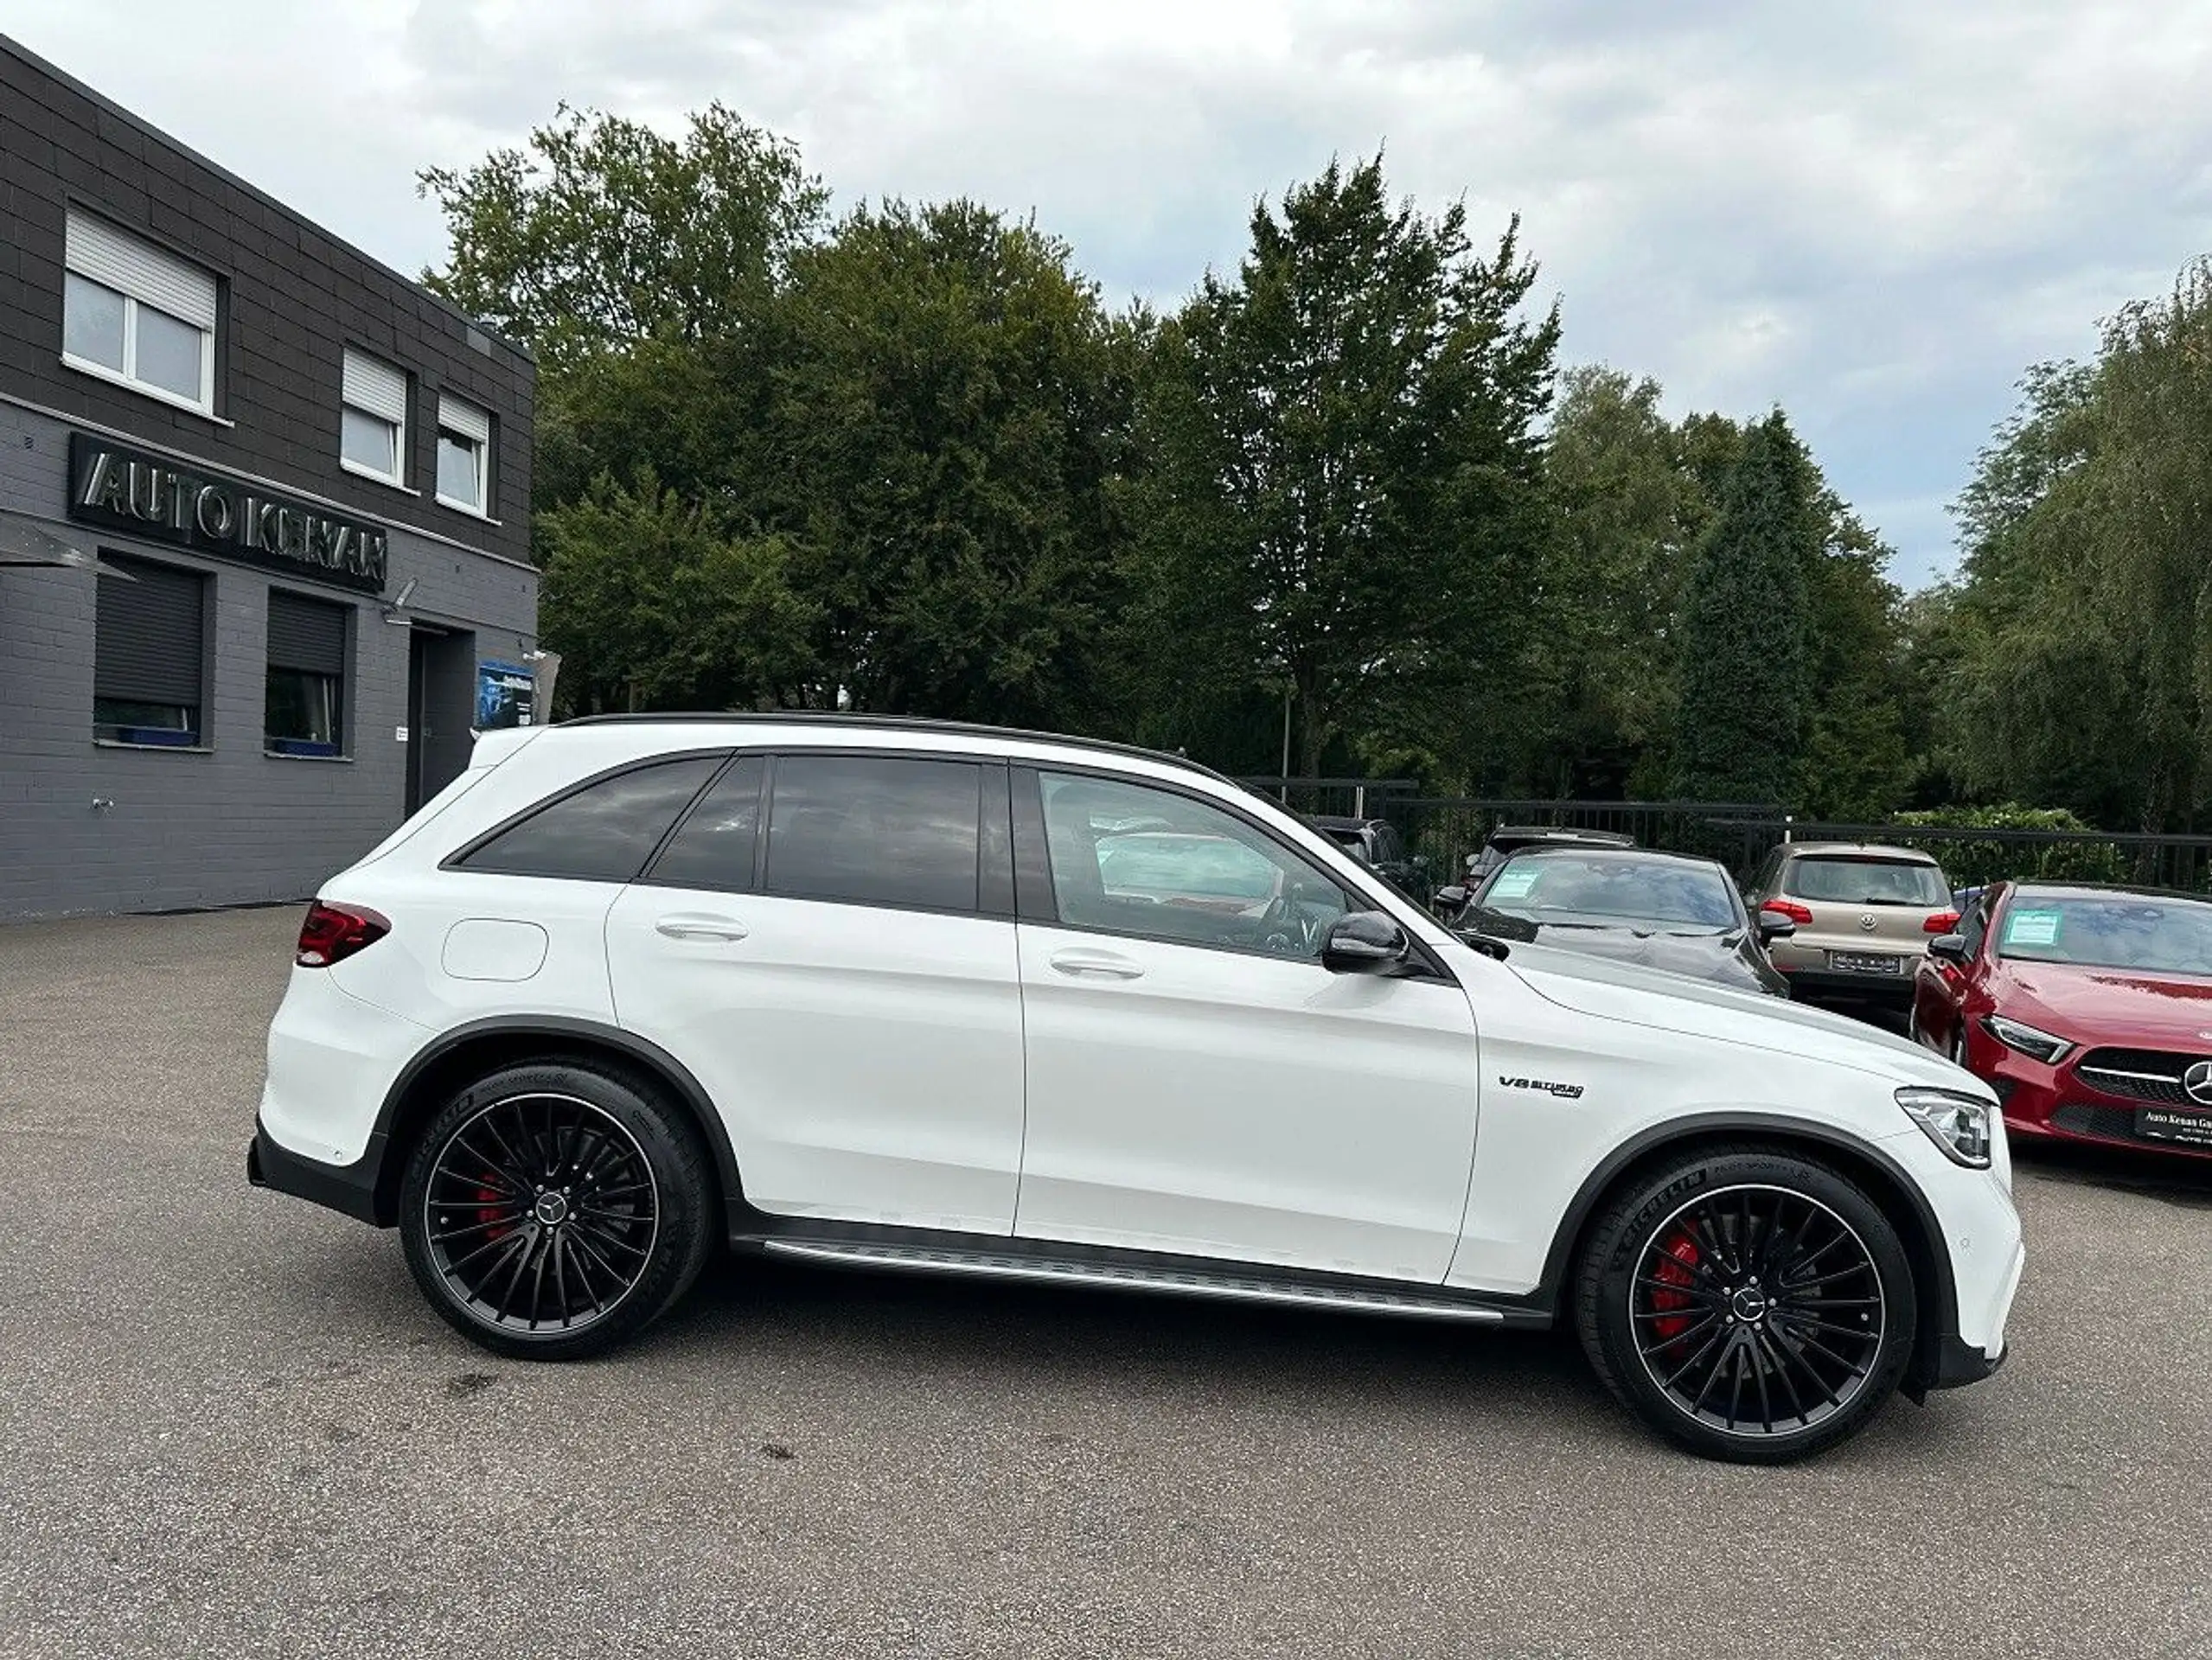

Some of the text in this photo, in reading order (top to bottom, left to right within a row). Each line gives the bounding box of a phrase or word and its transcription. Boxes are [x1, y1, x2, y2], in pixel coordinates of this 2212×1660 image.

[81, 451, 232, 540] AUTO
[1499, 1076, 1530, 1089] V8
[2145, 1111, 2168, 1123] Auto
[2168, 1114, 2197, 1127] Kenan
